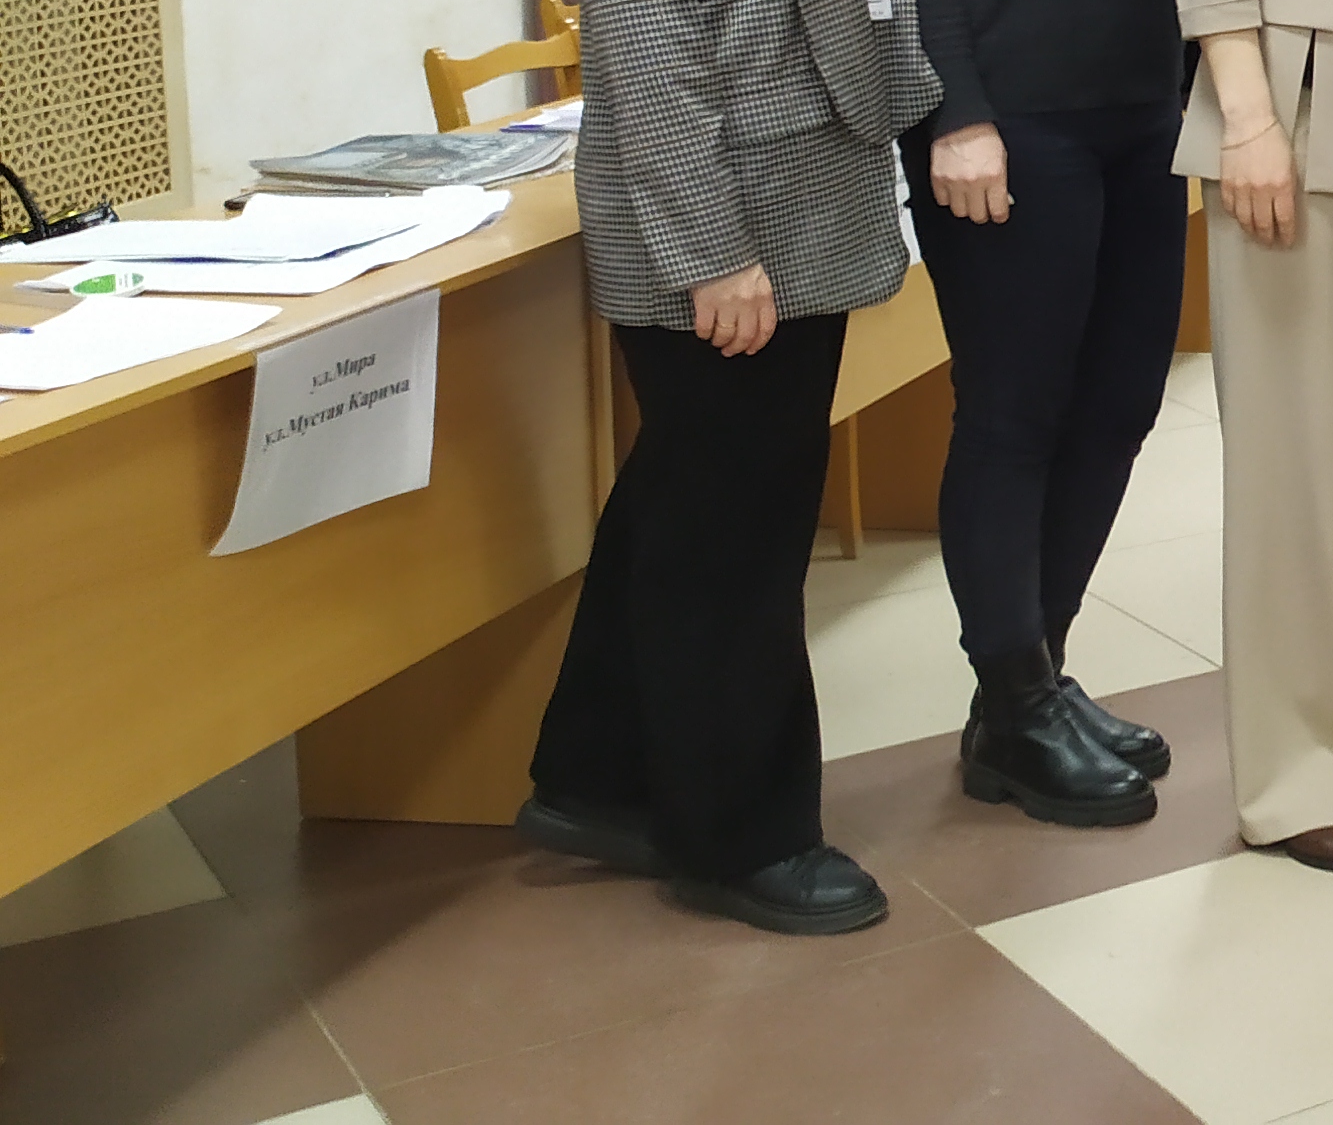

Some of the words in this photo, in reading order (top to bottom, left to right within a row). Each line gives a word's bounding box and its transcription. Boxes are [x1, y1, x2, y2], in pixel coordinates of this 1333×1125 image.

[309, 353, 377, 395] ул.Мира
[262, 401, 345, 453] ул.Мустая
[348, 378, 411, 410] Карима
